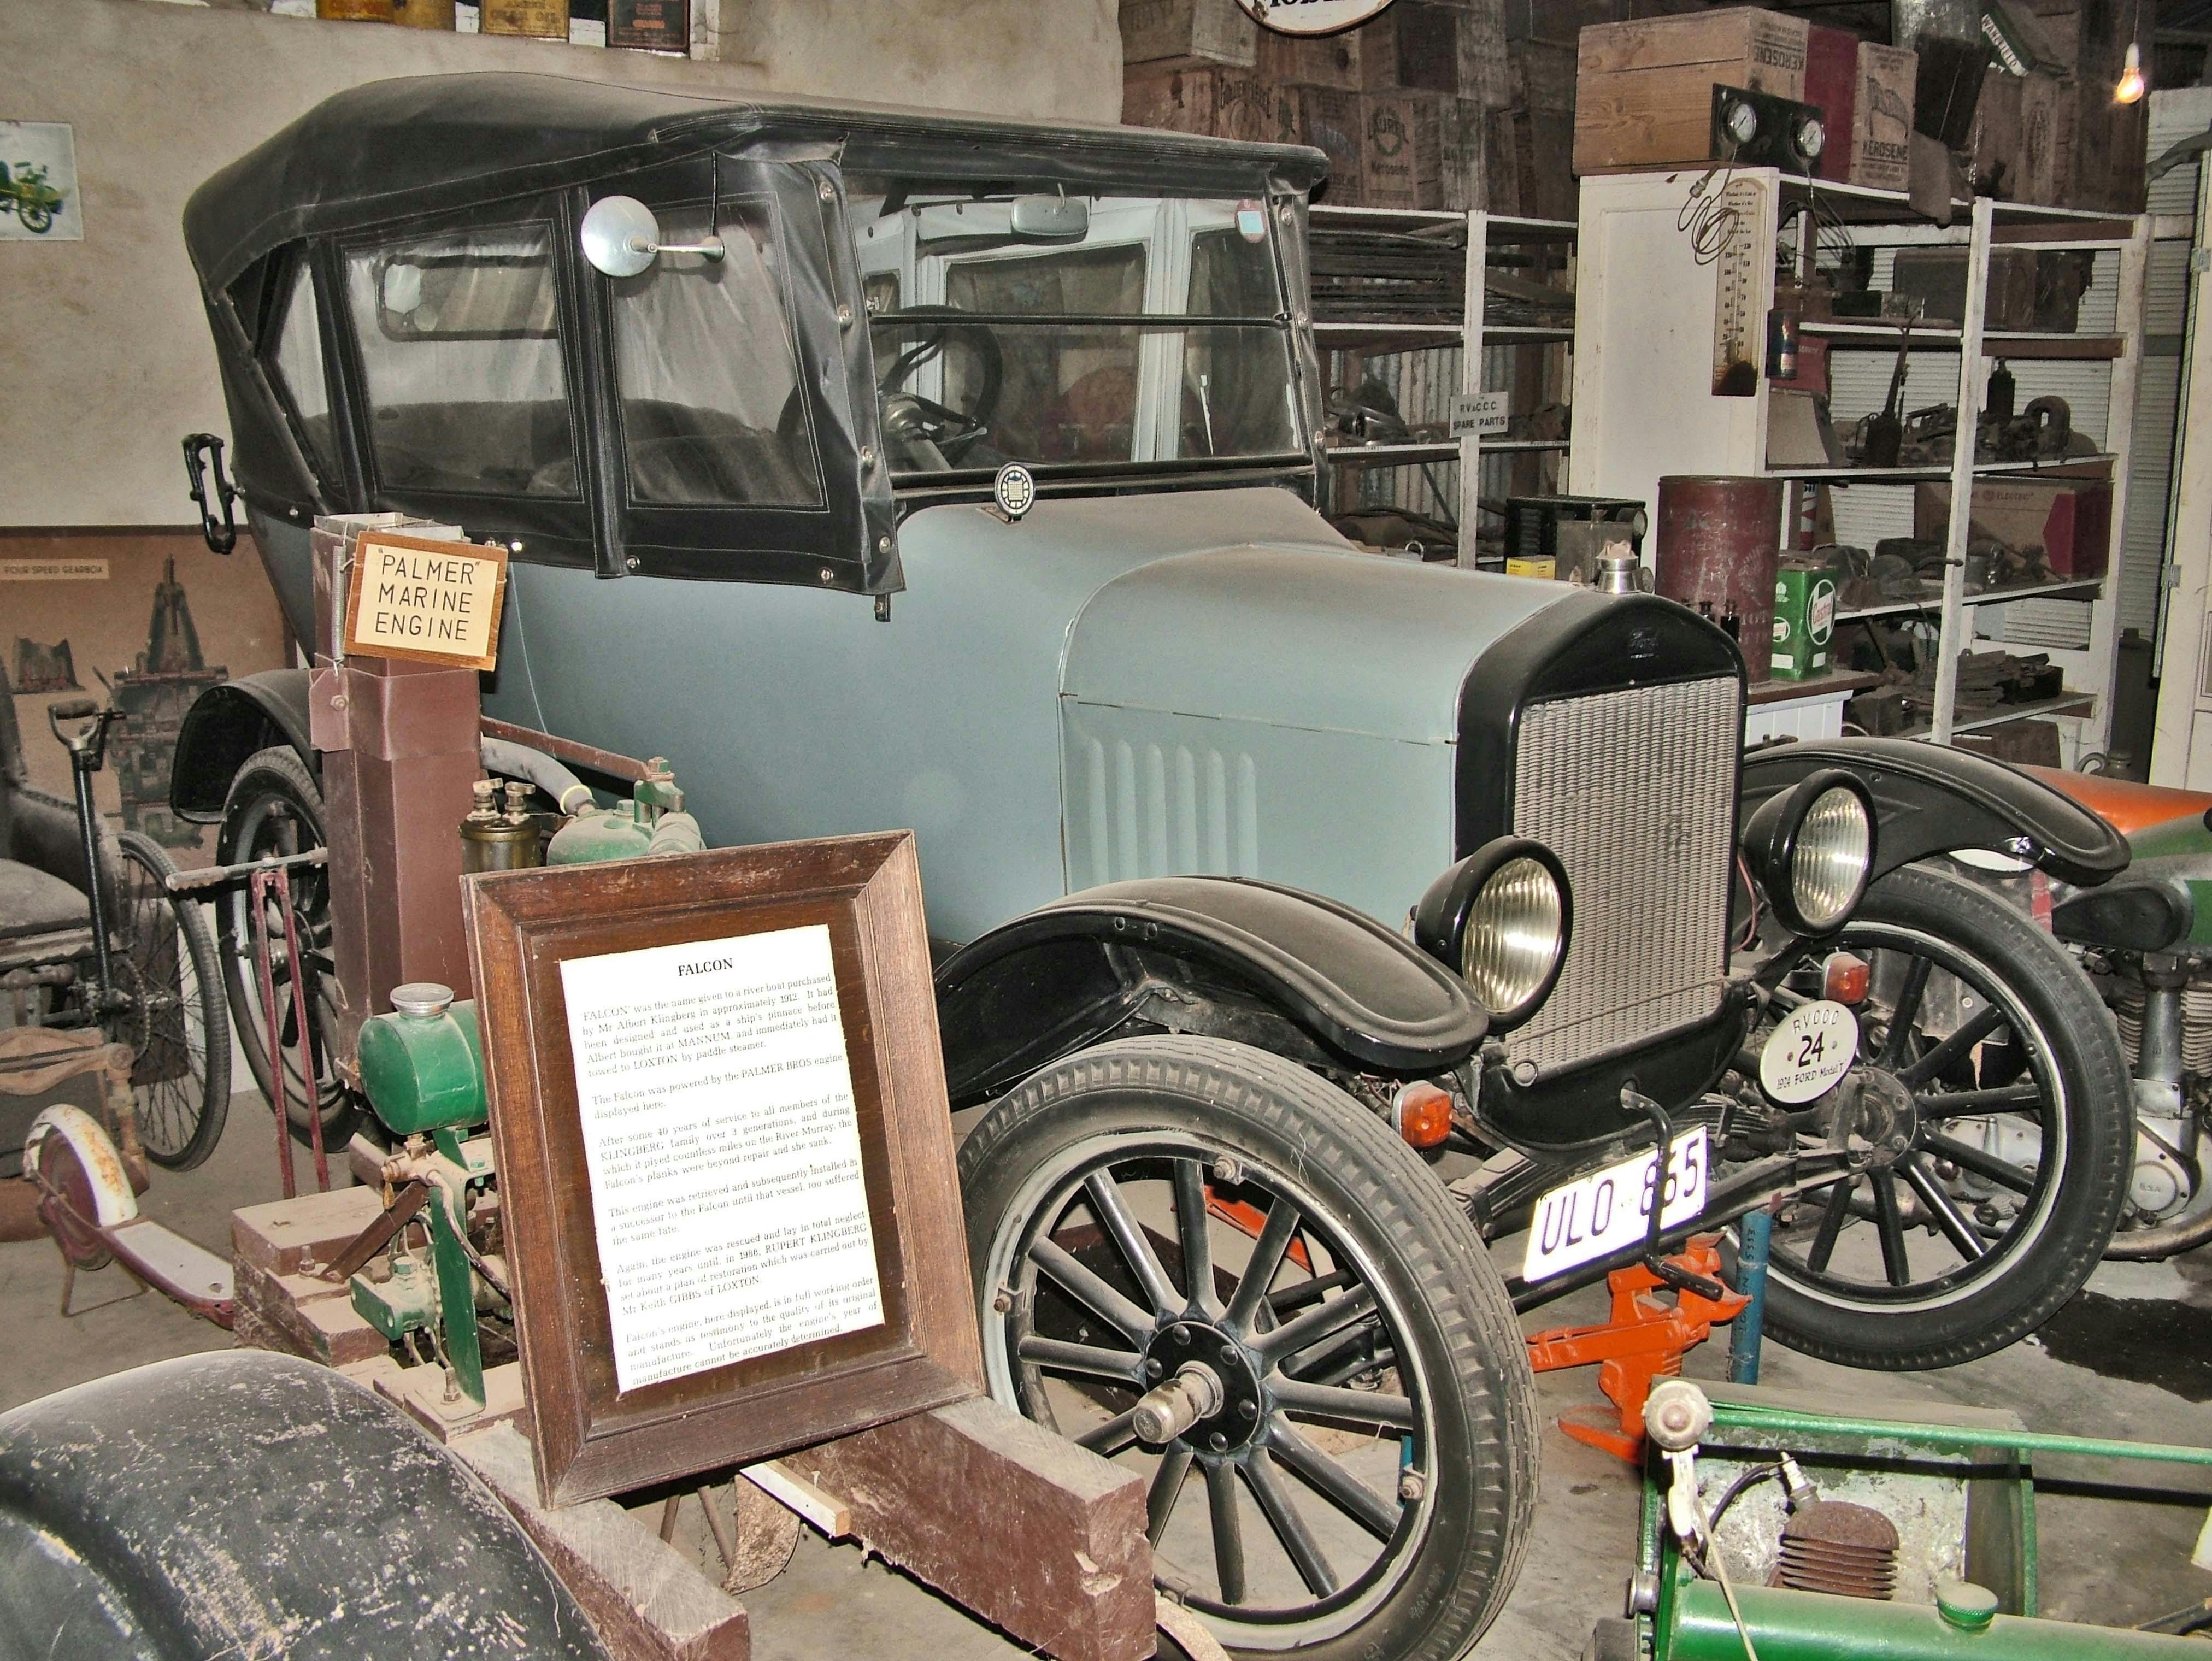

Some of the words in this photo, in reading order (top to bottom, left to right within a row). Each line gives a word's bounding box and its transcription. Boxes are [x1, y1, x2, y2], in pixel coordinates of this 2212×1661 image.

[1862, 140, 1908, 161] KEROSENE
[1453, 419, 1475, 430] SPARE
[1479, 416, 1505, 427] PARTS
[4, 566, 28, 574] FOUR
[32, 566, 59, 574] SPEED
[62, 565, 102, 574] GEARBOX
[379, 582, 473, 613] MARINE
[375, 611, 469, 640] ENGINE
[678, 957, 733, 976] FALCON
[617, 1018, 646, 1030] Albert
[712, 996, 775, 1016] approximately
[817, 986, 833, 997] had
[633, 1005, 652, 1013] was
[654, 1000, 669, 1010] the
[670, 998, 696, 1007] name
[698, 993, 722, 1004] given
[743, 986, 763, 996] river
[766, 982, 785, 992] boat
[787, 973, 831, 990] purchased
[584, 1040, 607, 1049] been
[613, 1029, 654, 1044] designed
[661, 1026, 677, 1036] and
[684, 1022, 704, 1033] used
[737, 1013, 762, 1024] ship's
[768, 1008, 802, 1021] pinnace
[807, 1002, 834, 1012] before
[587, 1051, 616, 1064] Albert
[620, 1045, 652, 1058] bought
[737, 1027, 752, 1038] and
[756, 1018, 808, 1034] immediately
[811, 1014, 827, 1024] had
[588, 1064, 617, 1077] towed
[634, 1054, 678, 1069] LOXTON
[696, 1046, 726, 1061] paddle
[1798, 1031, 1824, 1068] 24
[591, 1095, 611, 1105] The
[614, 1090, 645, 1102] Falcon
[648, 1087, 666, 1095] was
[669, 1075, 709, 1093] powered
[725, 1072, 739, 1081] the
[742, 1063, 784, 1078] PALMER
[786, 1058, 812, 1070] BROS
[814, 1053, 843, 1064] engine
[1795, 1070, 1817, 1085] FORD
[1820, 1065, 1838, 1079] Model
[594, 1103, 639, 1119] displayed
[598, 1136, 623, 1147] After
[628, 1132, 652, 1141] some
[673, 1123, 697, 1135] years
[715, 1114, 747, 1125] service
[764, 1105, 775, 1115] all
[779, 1099, 818, 1112] members
[670, 1134, 699, 1148] family
[706, 1132, 725, 1140] over
[822, 1107, 850, 1117] during
[603, 1162, 631, 1175] which
[673, 1147, 716, 1161] countless
[719, 1141, 743, 1152] miles
[775, 1130, 798, 1141] River
[604, 1177, 643, 1189] Falcon's
[647, 1168, 678, 1183] planks
[681, 1164, 704, 1174] were
[707, 1154, 740, 1169] beyond
[743, 1150, 768, 1162] repair
[608, 1206, 629, 1217] This
[632, 1200, 663, 1212] engine
[688, 1183, 729, 1201] retrieved
[751, 1169, 808, 1187] subsequently
[619, 1214, 664, 1230] successor
[698, 1201, 728, 1213] Falcon
[732, 1194, 753, 1205] until
[756, 1190, 773, 1200] that
[825, 1170, 859, 1185] suffered
[631, 1231, 655, 1241] same
[670, 1250, 701, 1261] engine
[726, 1233, 760, 1249] rescued
[812, 1216, 831, 1229] total
[834, 1210, 865, 1224] neglect
[1541, 1179, 1614, 1256] ULO
[637, 1272, 662, 1283] many
[668, 1266, 692, 1278] years
[765, 1236, 805, 1253] RUPERT
[637, 1285, 662, 1298] about
[674, 1280, 695, 1291] plan
[710, 1264, 757, 1281] restoration
[760, 1255, 787, 1268] which
[810, 1242, 840, 1257] carried
[626, 1327, 665, 1343] Falcon's
[704, 1315, 724, 1324] here
[795, 1290, 810, 1301] full
[814, 1283, 850, 1297] working
[852, 1277, 873, 1288] order
[669, 1291, 701, 1303] GIBBS
[651, 1337, 681, 1351] stands
[779, 1305, 809, 1320] quality
[843, 1288, 875, 1303] original
[709, 1328, 771, 1351] Unfortunately
[799, 1312, 836, 1327] engine's
[843, 1307, 860, 1318] year
[633, 1364, 691, 1385] manufacture
[694, 1354, 725, 1368] cannot
[743, 1338, 789, 1355] accurately
[791, 1324, 839, 1343] determined.
